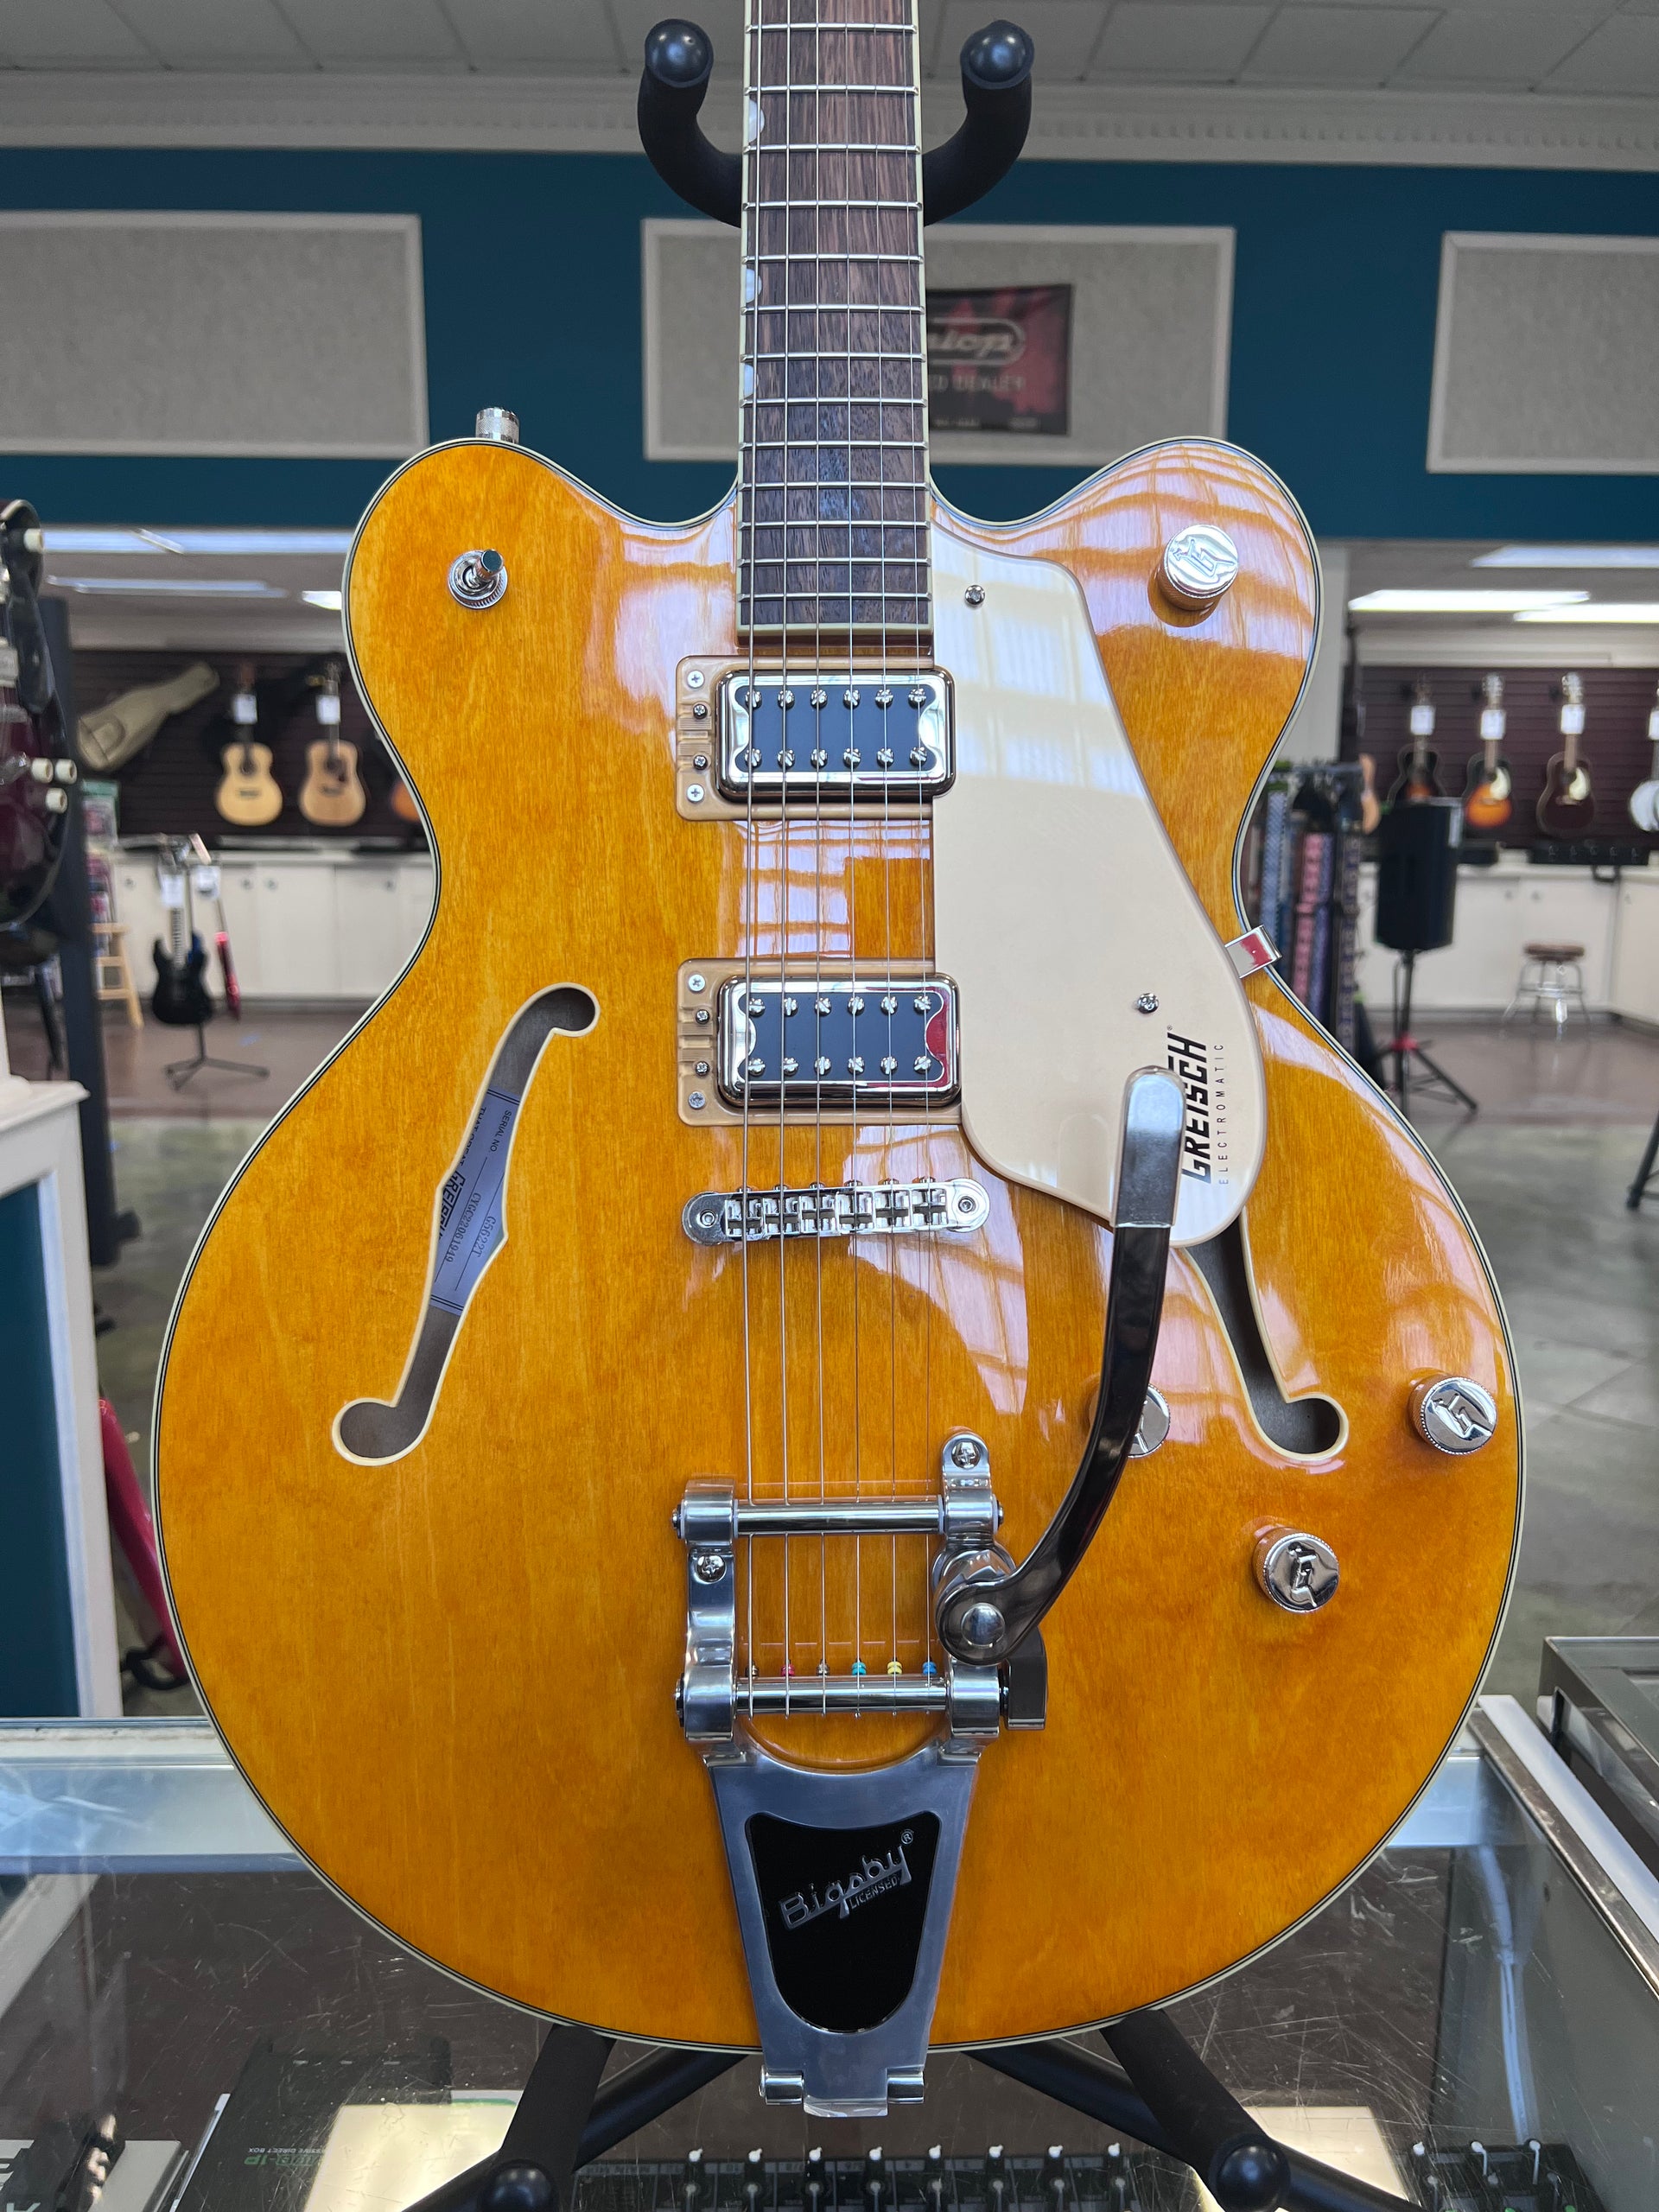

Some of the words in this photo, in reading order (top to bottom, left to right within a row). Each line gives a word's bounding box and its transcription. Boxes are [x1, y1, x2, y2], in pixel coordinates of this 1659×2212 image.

[928, 329, 1013, 359] nlop
[494, 1109, 512, 1137] SERIAL
[1213, 1044, 1230, 1185] ELECTROMATIC
[473, 1215, 497, 1258] G5622T
[779, 1844, 912, 1930] Bigsby
[848, 1873, 902, 1910] LICENSED
